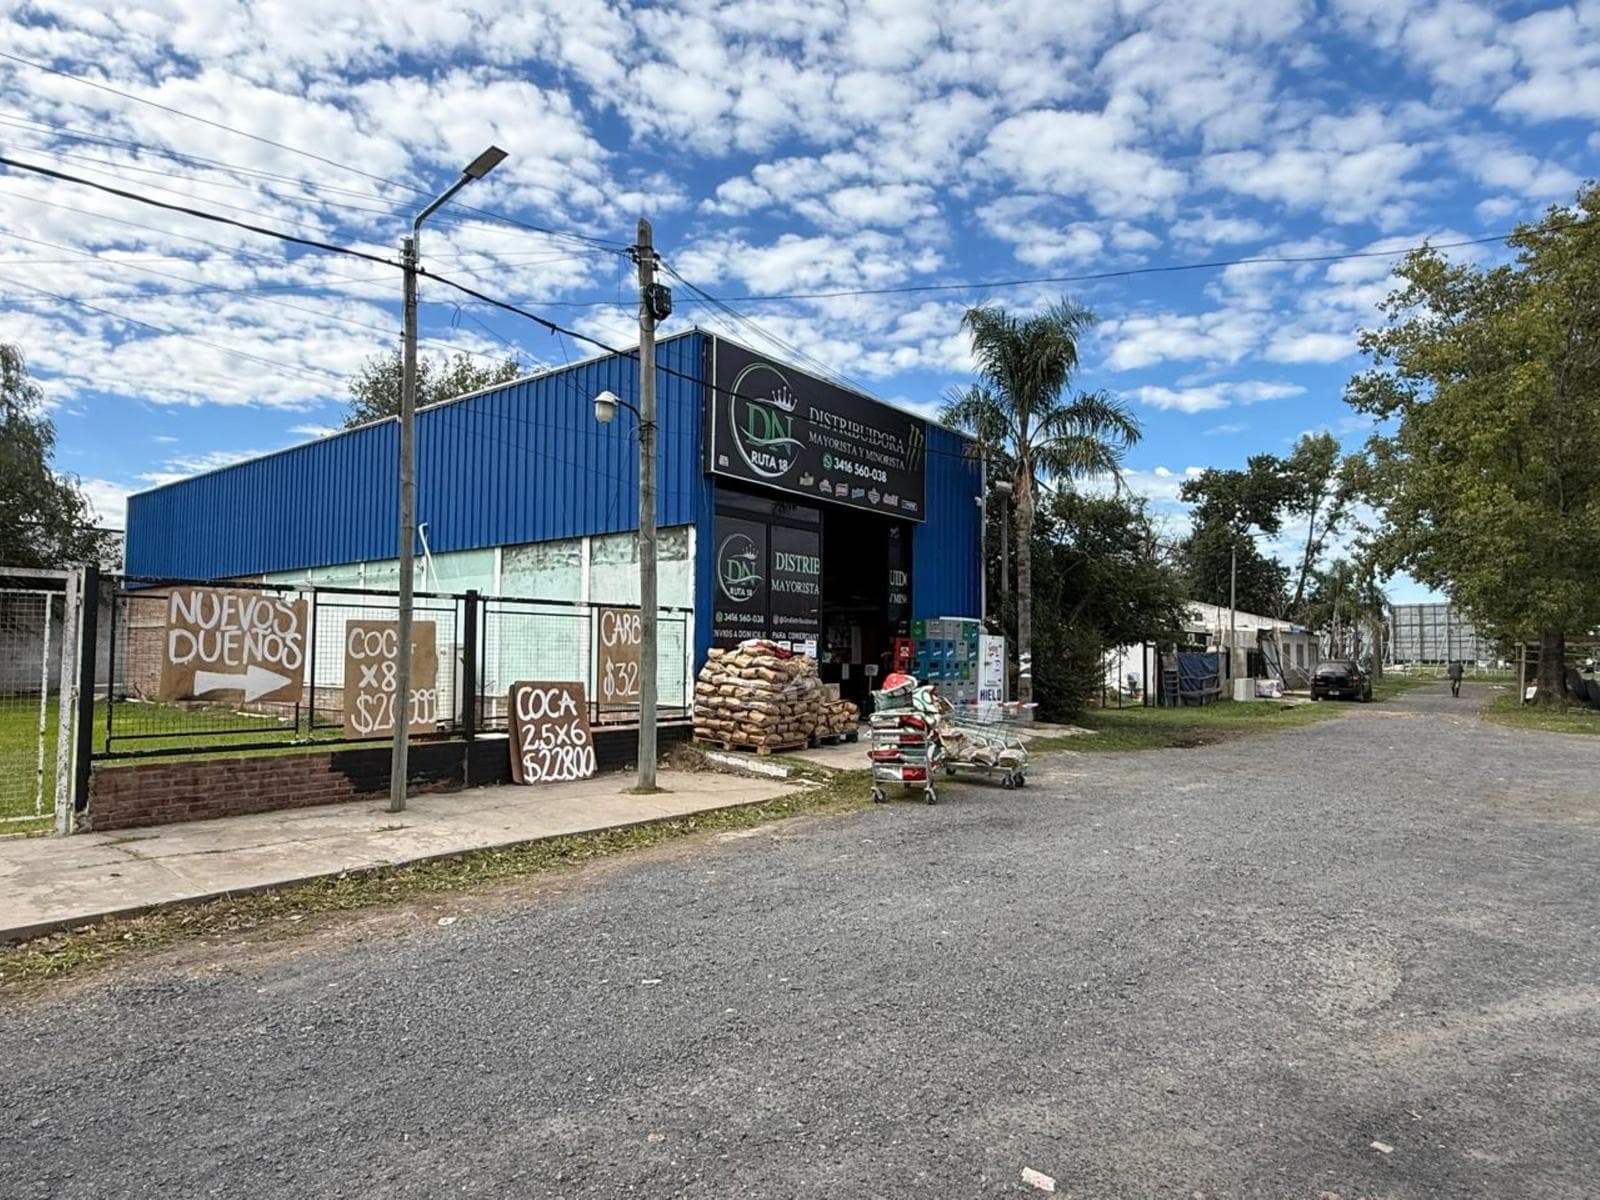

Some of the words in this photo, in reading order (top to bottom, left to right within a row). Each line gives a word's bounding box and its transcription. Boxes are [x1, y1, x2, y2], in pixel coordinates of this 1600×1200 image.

[808, 406, 905, 454] DISTRIBUIDORA
[751, 450, 777, 470] RUTA
[778, 458, 789, 472] 18
[808, 430, 858, 456] MAYORISTA
[858, 446, 866, 458] Y
[865, 449, 906, 471] MINORISTA
[833, 457, 853, 473] 3416
[854, 462, 887, 483] 560-038
[771, 578, 820, 595] MAYORISTA
[170, 591, 298, 638] NUEVOS
[168, 627, 301, 670] DUEÑOS
[348, 628, 416, 659] COC
[516, 686, 578, 721] COCA
[523, 746, 595, 785] $22800
